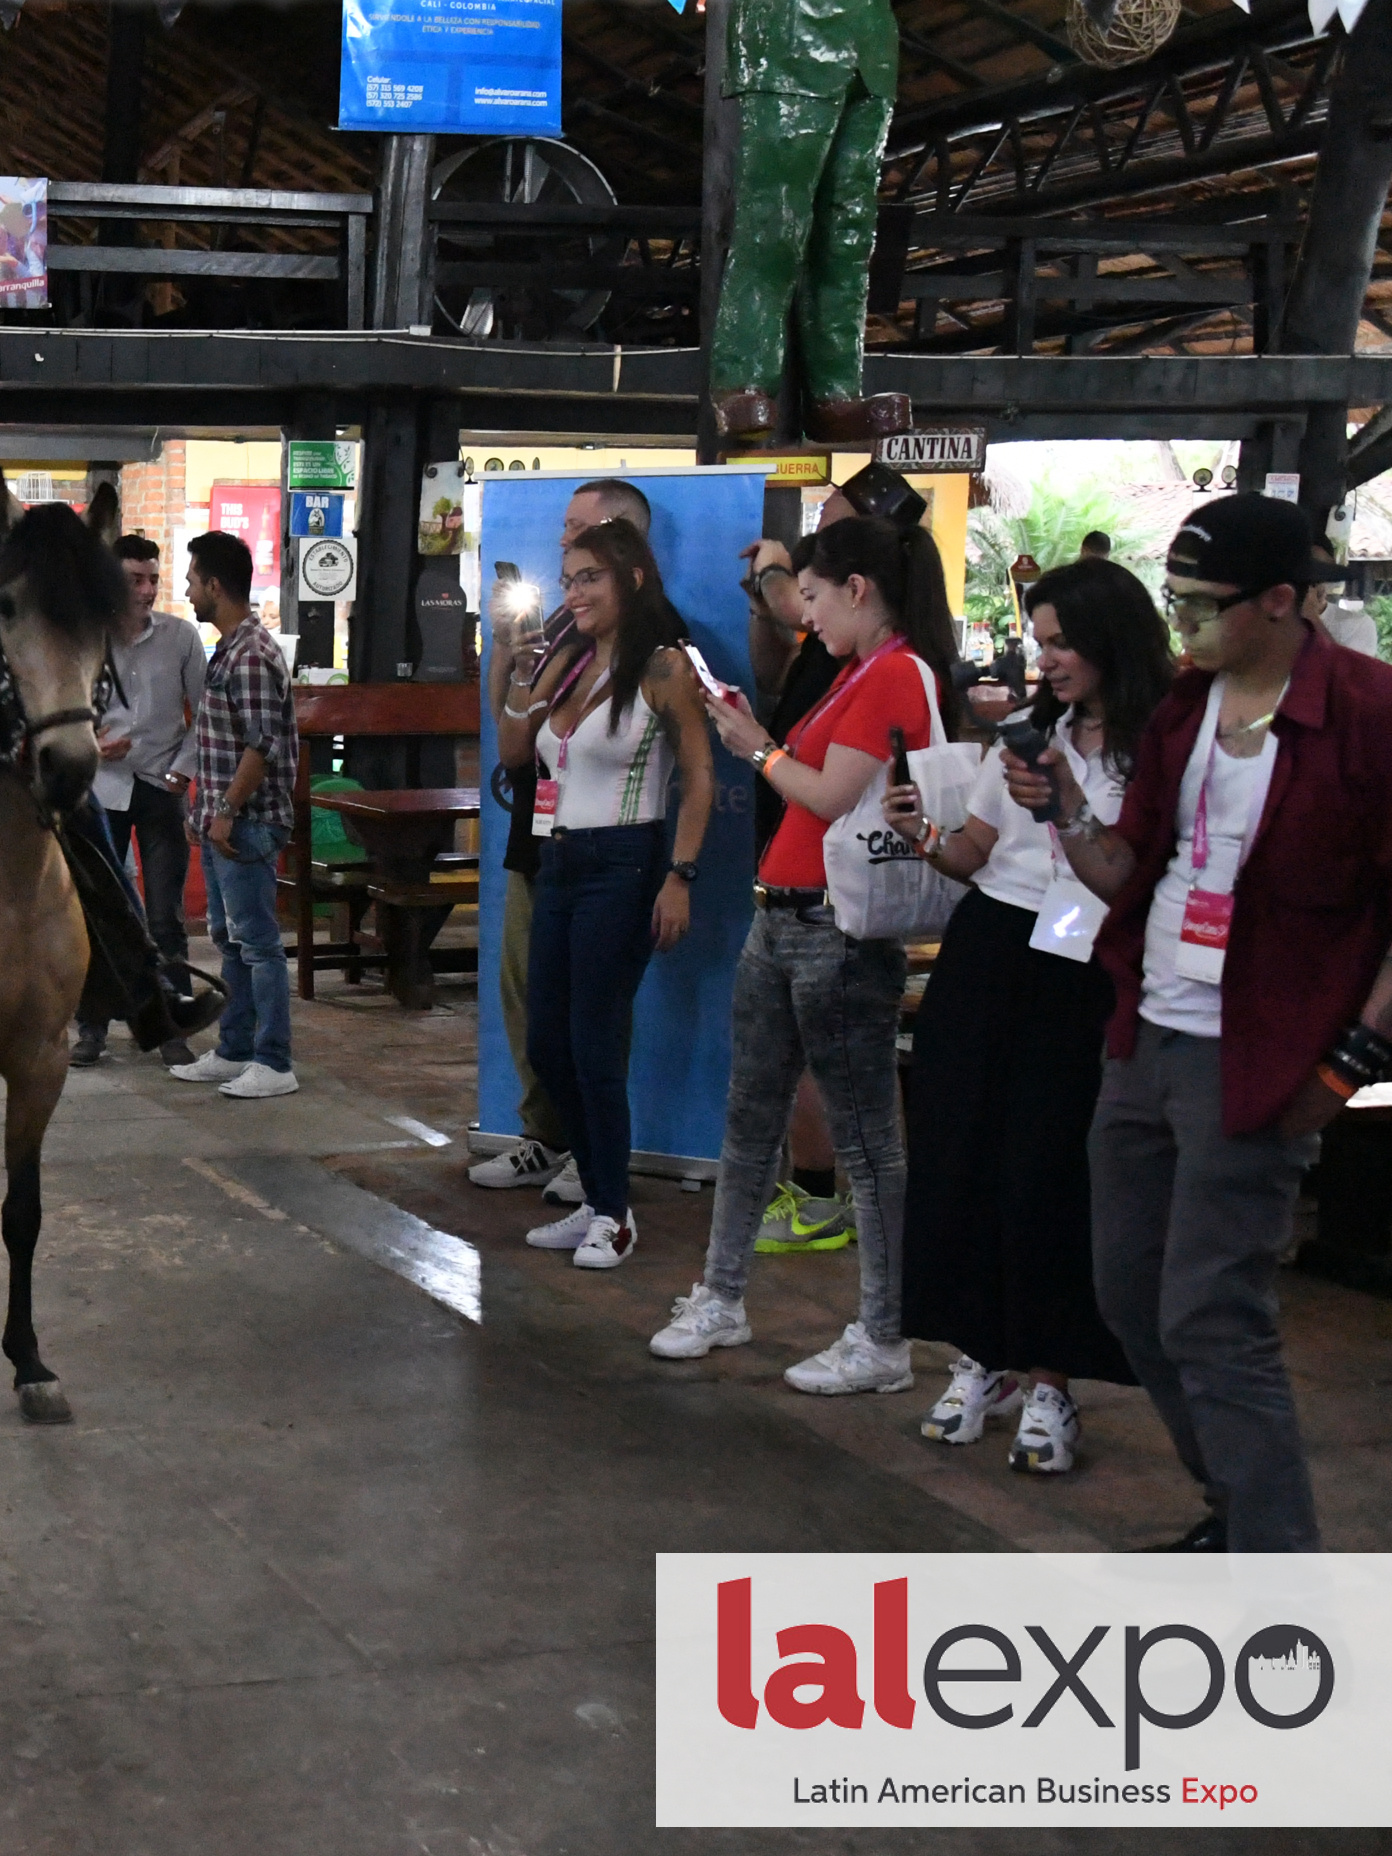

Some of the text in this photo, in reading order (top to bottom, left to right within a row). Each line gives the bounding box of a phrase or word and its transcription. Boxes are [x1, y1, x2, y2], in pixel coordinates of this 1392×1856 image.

[420, 0, 441, 8] CALI
[450, 2, 496, 10] COLOMBIA
[464, 17, 480, 25] CON
[886, 436, 973, 461] CANTINA
[305, 495, 329, 508] BAR
[220, 503, 243, 516] THIS
[220, 516, 250, 530] BUD'S
[309, 543, 348, 563] ESTABLECIMIENTO
[313, 581, 343, 591] AUTORIZADO
